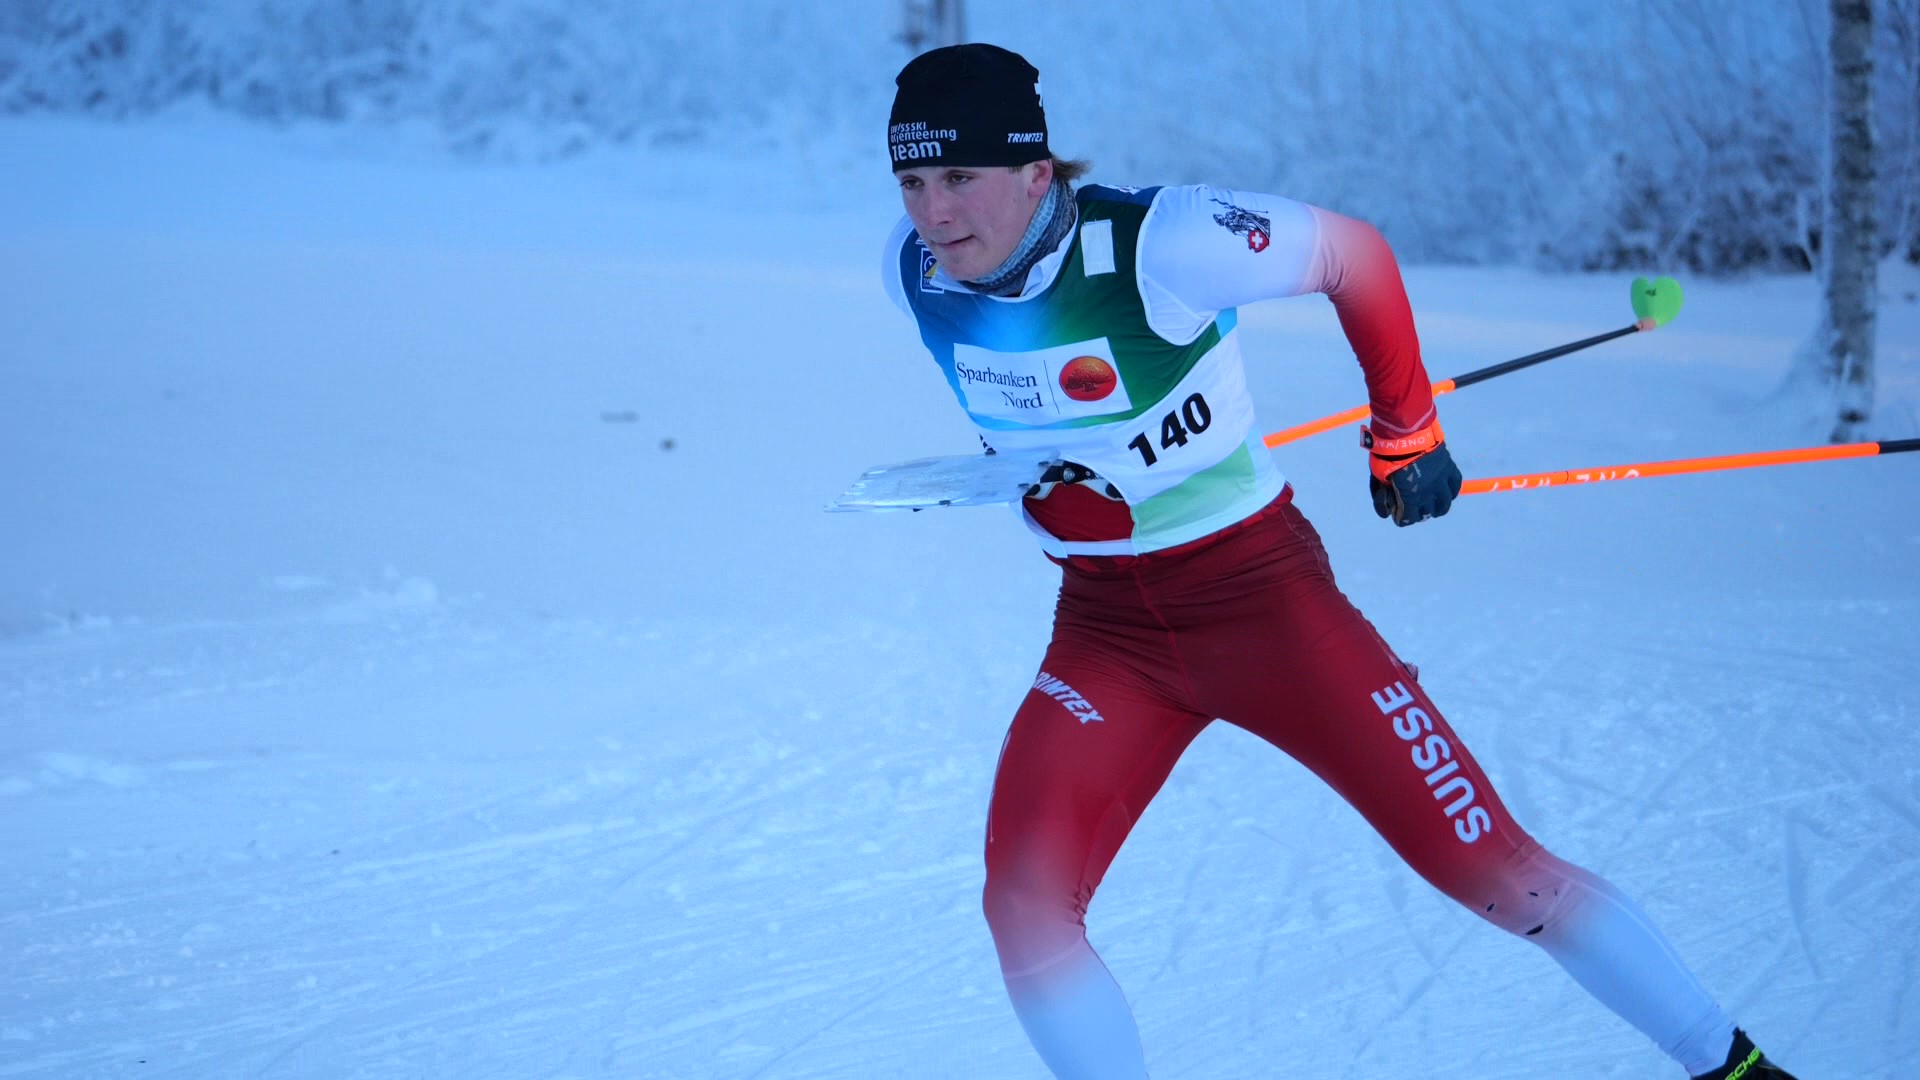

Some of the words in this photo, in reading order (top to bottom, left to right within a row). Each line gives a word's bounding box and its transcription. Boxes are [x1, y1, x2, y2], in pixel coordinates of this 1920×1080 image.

[1007, 132, 1044, 143] TRIMTEX
[892, 141, 942, 161] team
[956, 362, 1037, 388] Sparbanken
[1001, 390, 1043, 409] Nord
[1128, 392, 1212, 467] 140
[1033, 671, 1105, 724] RIMTEX
[1371, 681, 1492, 843] SUISSE
